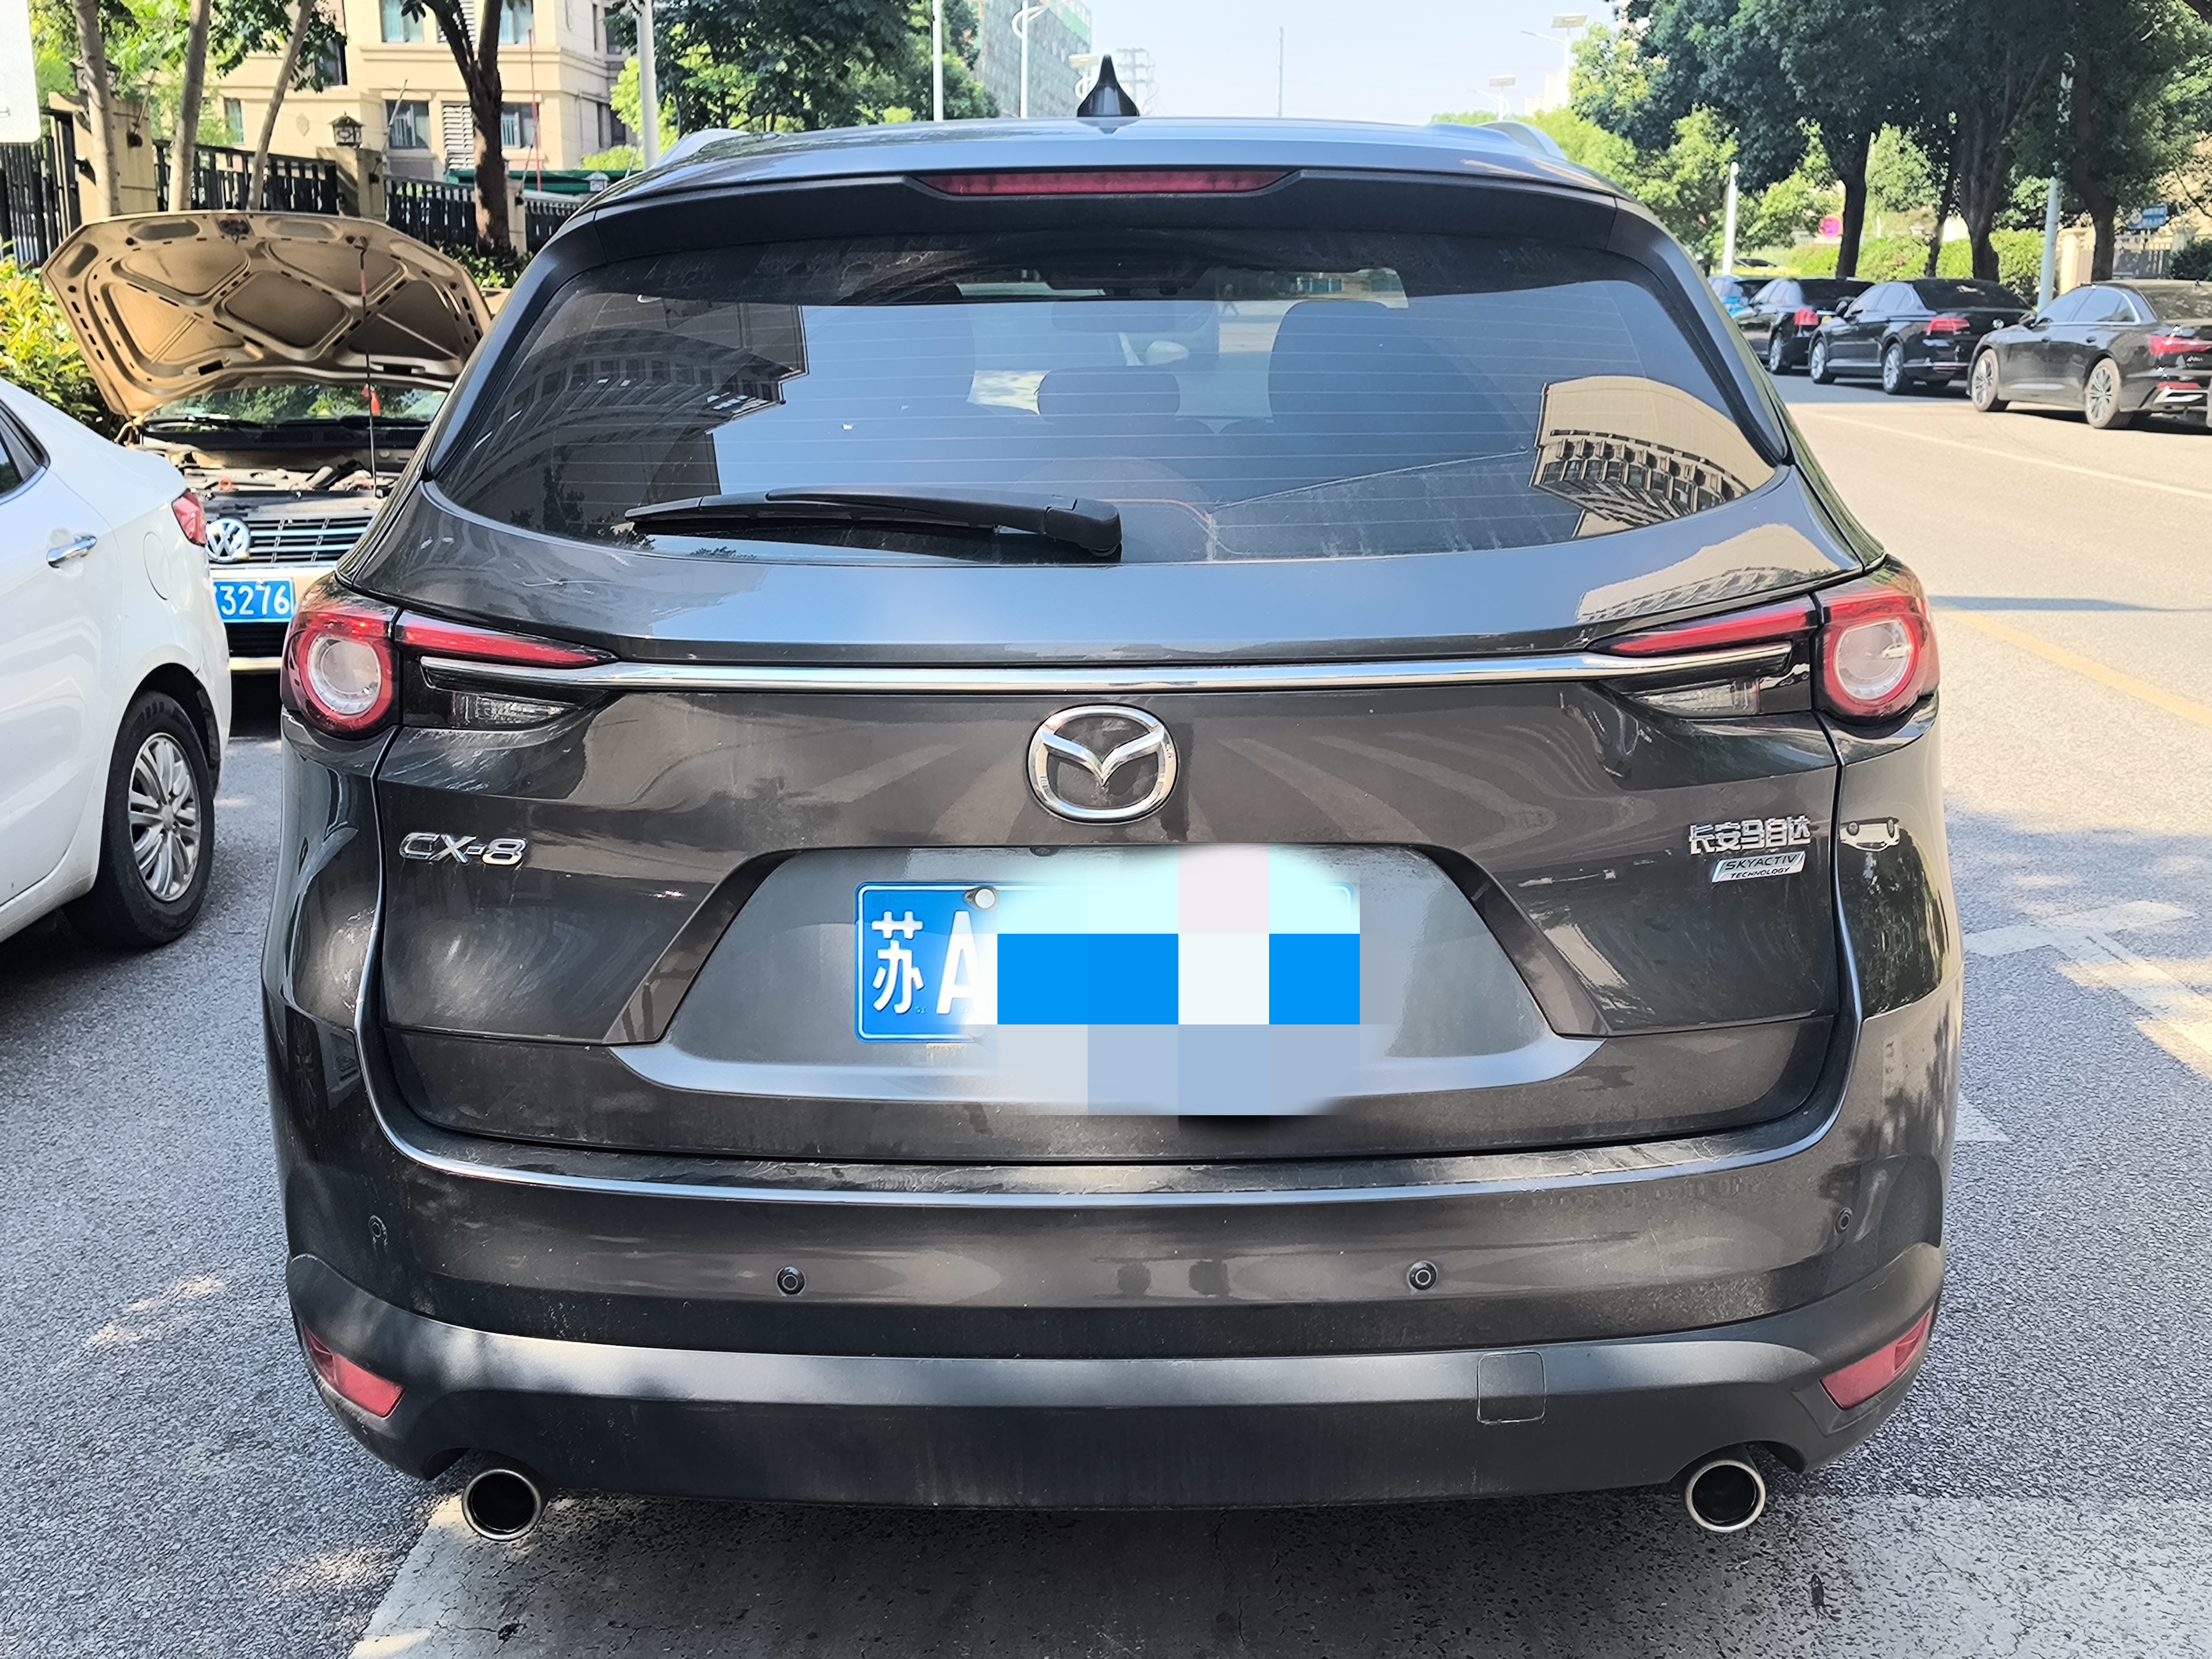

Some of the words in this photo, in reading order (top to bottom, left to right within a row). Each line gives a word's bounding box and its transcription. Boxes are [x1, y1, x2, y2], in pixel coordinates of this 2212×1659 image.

[213, 584, 290, 616] 3276
[399, 832, 528, 865] CX-8
[1689, 815, 1811, 855] 长安马自达
[1725, 854, 1798, 871] SKYACTIV
[1730, 867, 1791, 879] TECHNOLOGY
